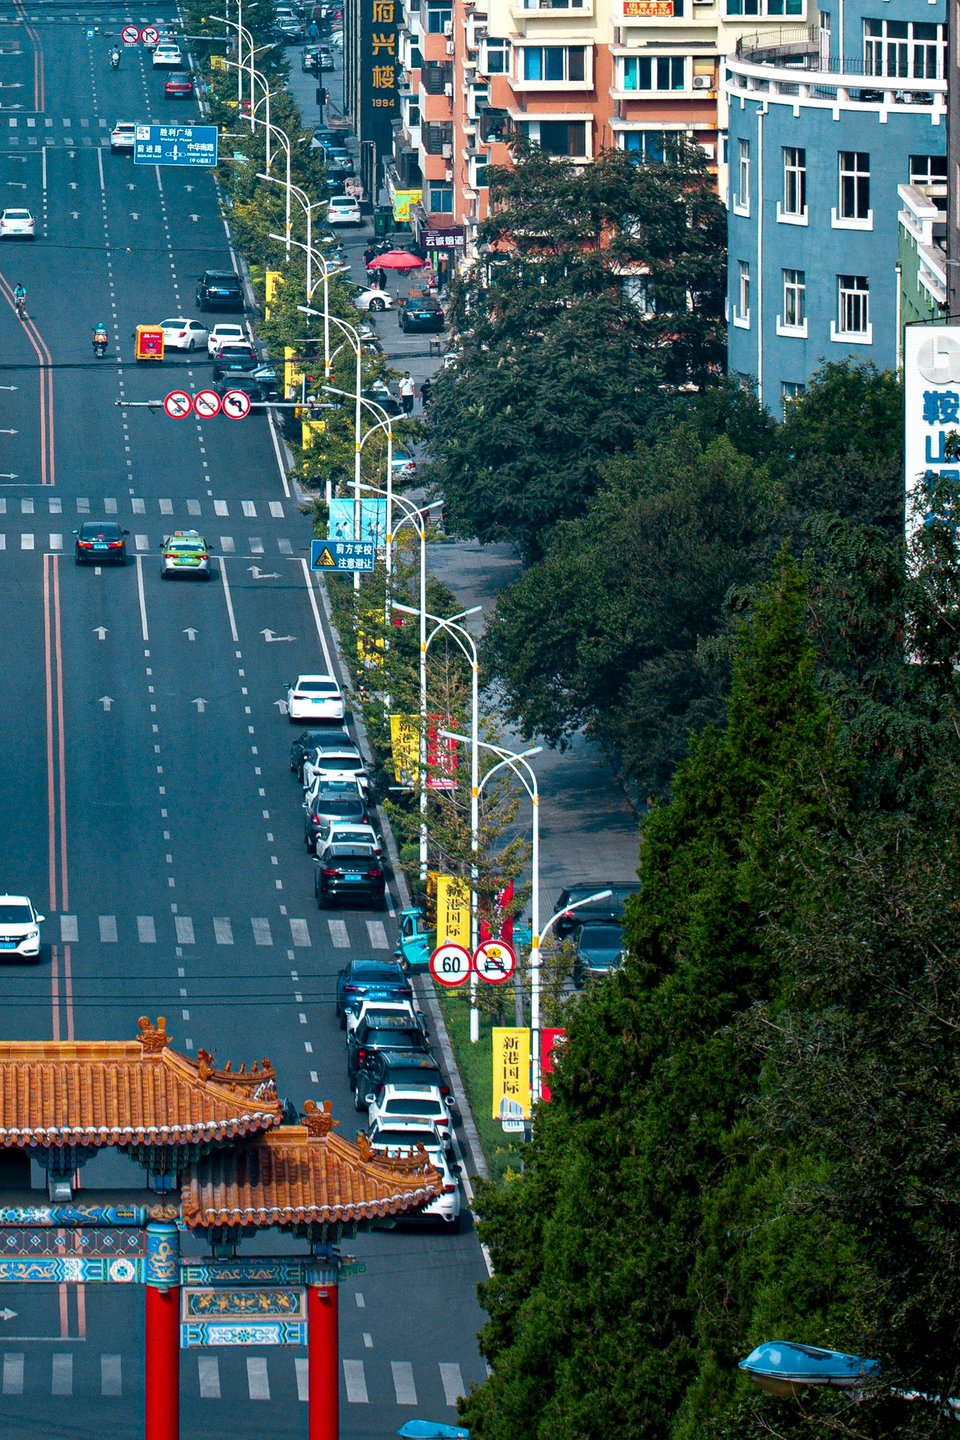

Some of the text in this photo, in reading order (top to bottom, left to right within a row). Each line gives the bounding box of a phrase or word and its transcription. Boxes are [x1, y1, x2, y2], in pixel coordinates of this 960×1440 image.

[371, 0, 395, 88] 府兴楼
[371, 98, 395, 108] 1994
[160, 128, 193, 137] 胜利广场
[137, 144, 162, 153] 前进路
[336, 543, 372, 555] 前方学校
[442, 956, 461, 973] 60
[503, 1036, 519, 1094] 新港国际
